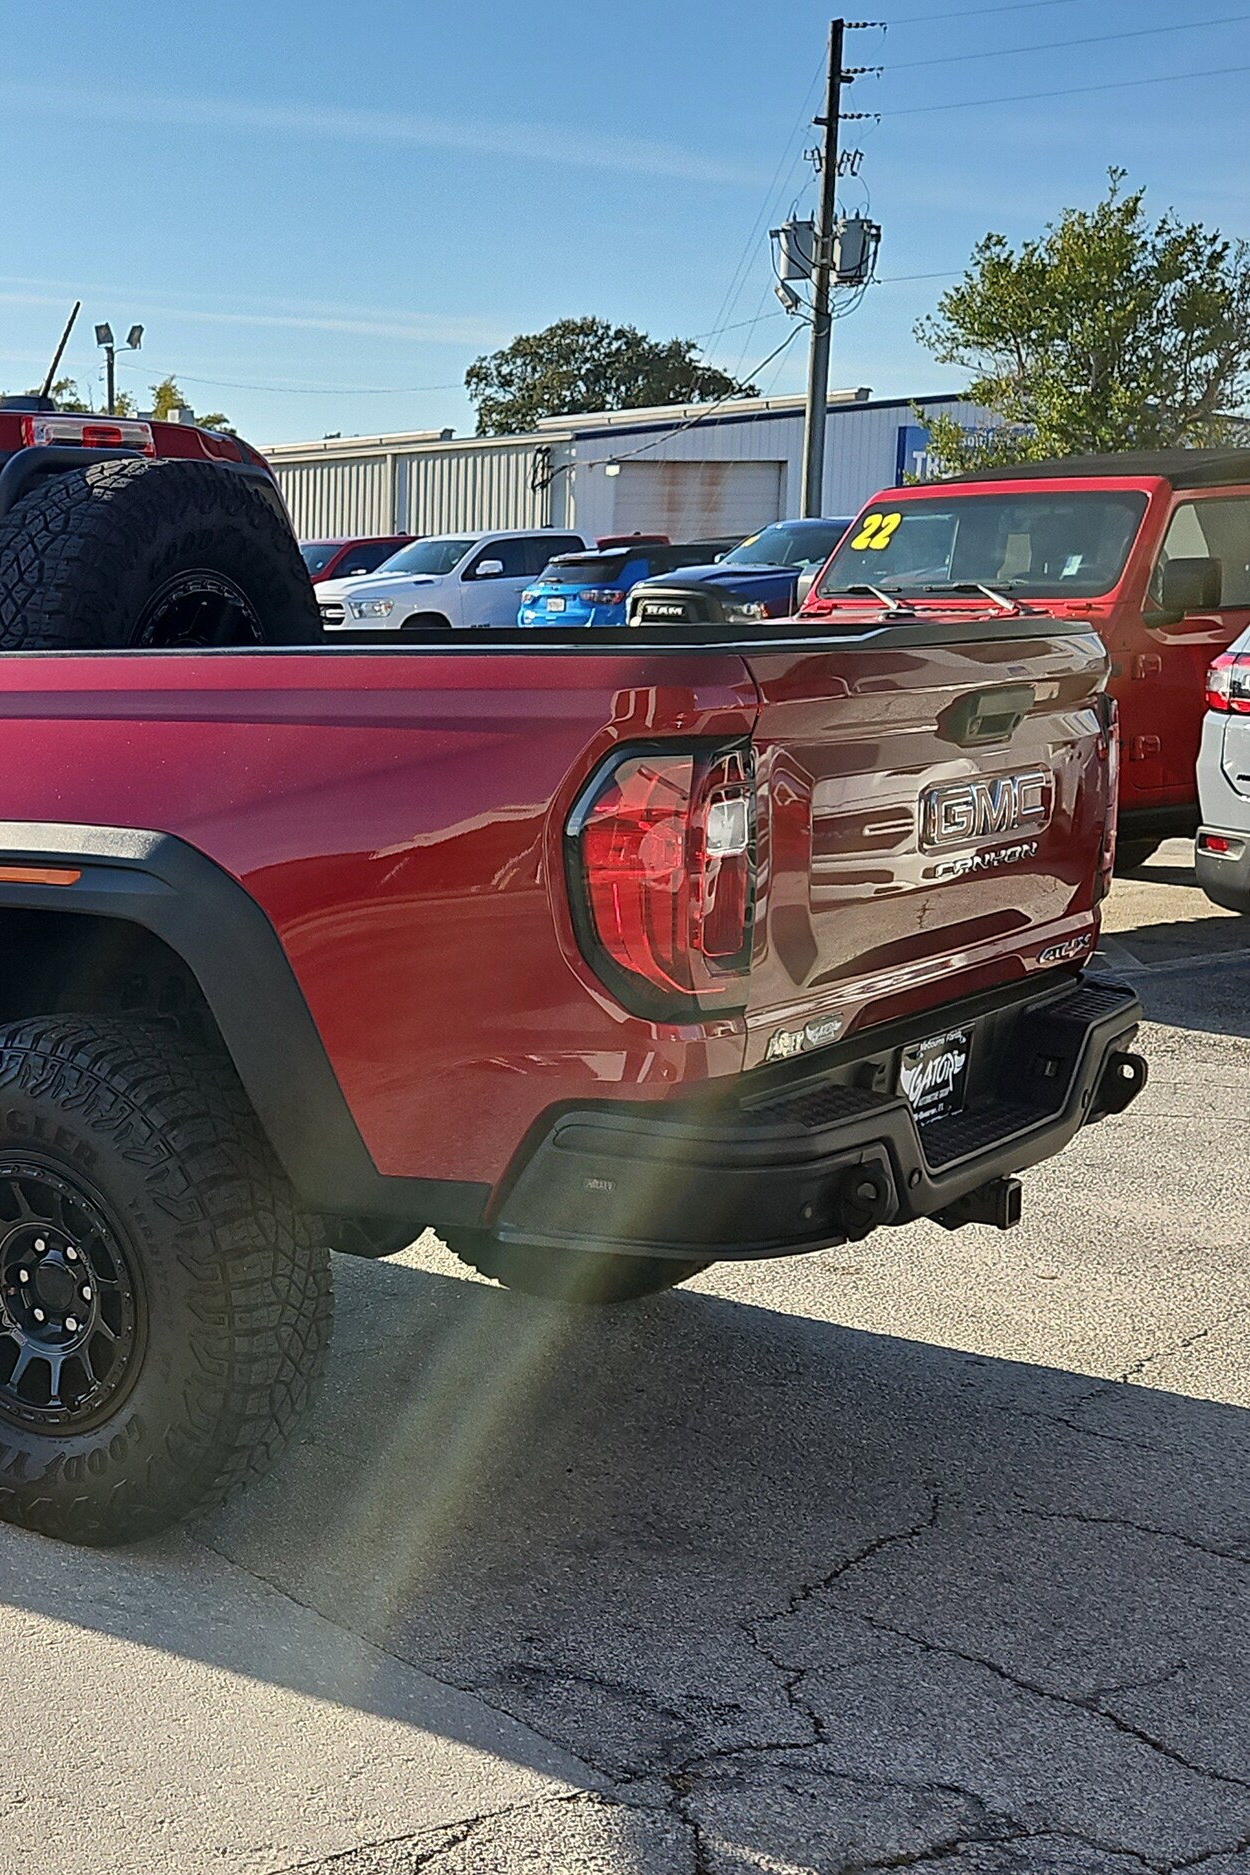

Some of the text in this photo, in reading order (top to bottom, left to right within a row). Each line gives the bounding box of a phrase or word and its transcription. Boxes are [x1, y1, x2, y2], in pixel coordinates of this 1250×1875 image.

[851, 512, 902, 550] 22
[644, 604, 685, 617] RAM
[933, 772, 1047, 844] GMC
[934, 841, 1039, 879] CANYON
[909, 1052, 954, 1109] GATOR
